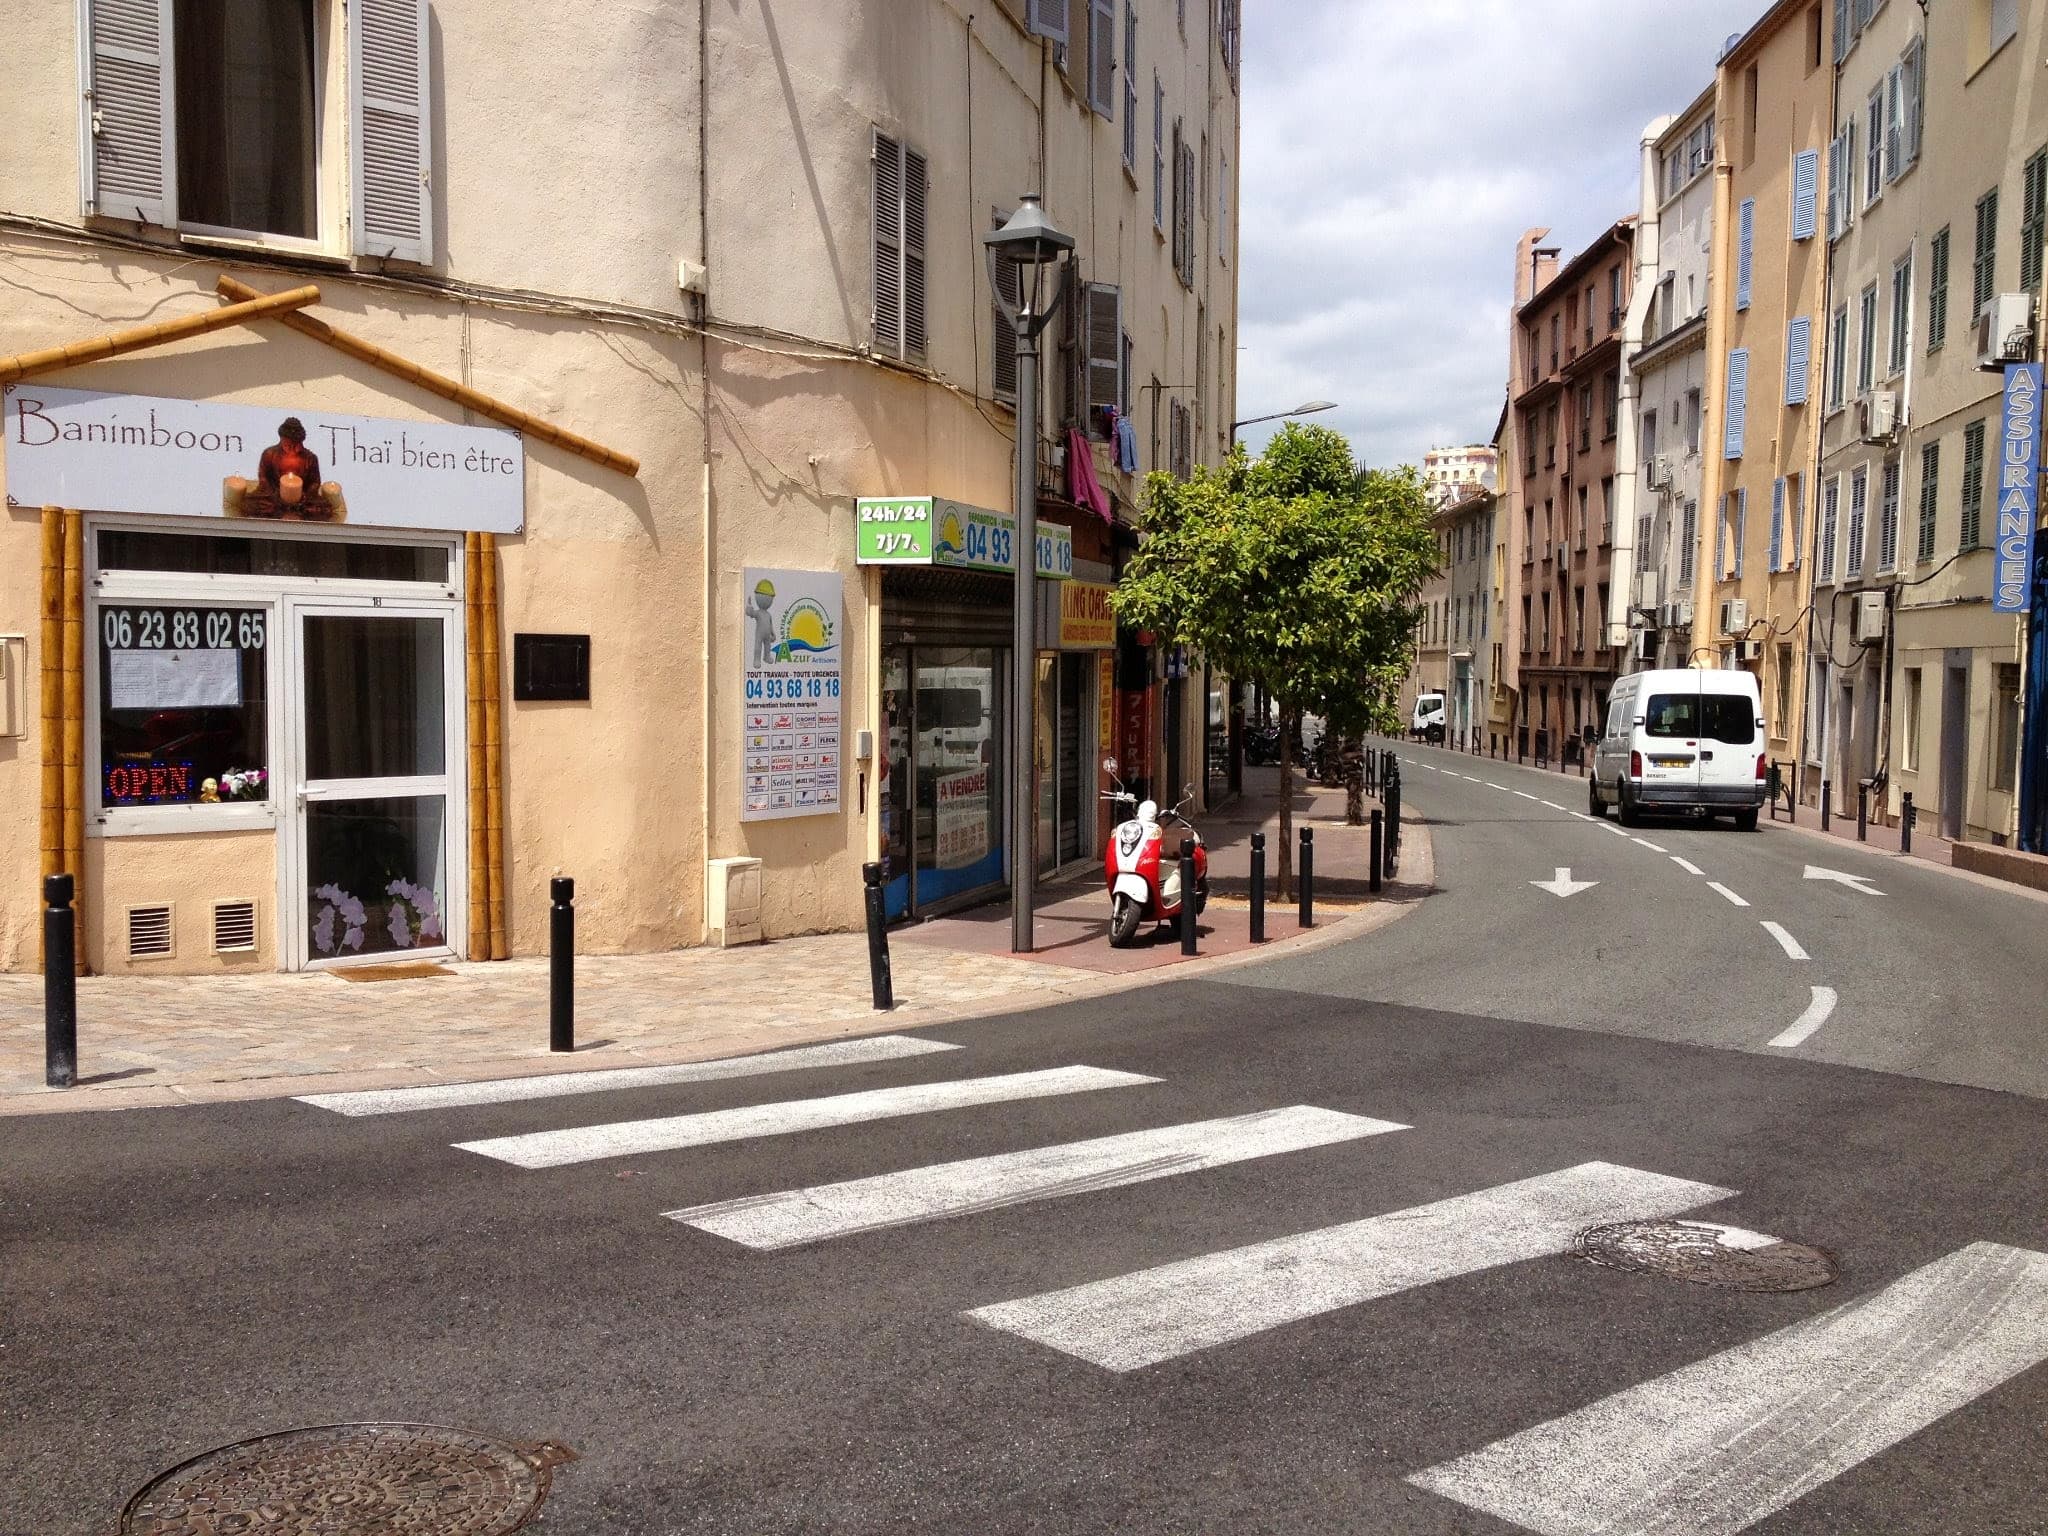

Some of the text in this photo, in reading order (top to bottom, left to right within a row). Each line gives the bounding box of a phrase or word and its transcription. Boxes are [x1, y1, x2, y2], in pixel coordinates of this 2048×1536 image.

[16, 398, 243, 453] Banimboon
[320, 424, 514, 476] Thaï bien être
[1997, 368, 2036, 608] ASSURANCES
[861, 504, 927, 522] 24h/24
[876, 532, 912, 554] 7j/7
[967, 523, 1071, 572] 04 93 18 18
[1063, 585, 1085, 618] KING
[105, 610, 264, 649] 06 23 83 02 65
[746, 678, 839, 699] 04 93 68 18 18
[109, 767, 188, 797] OPEN
[950, 773, 985, 799] VENDRE
